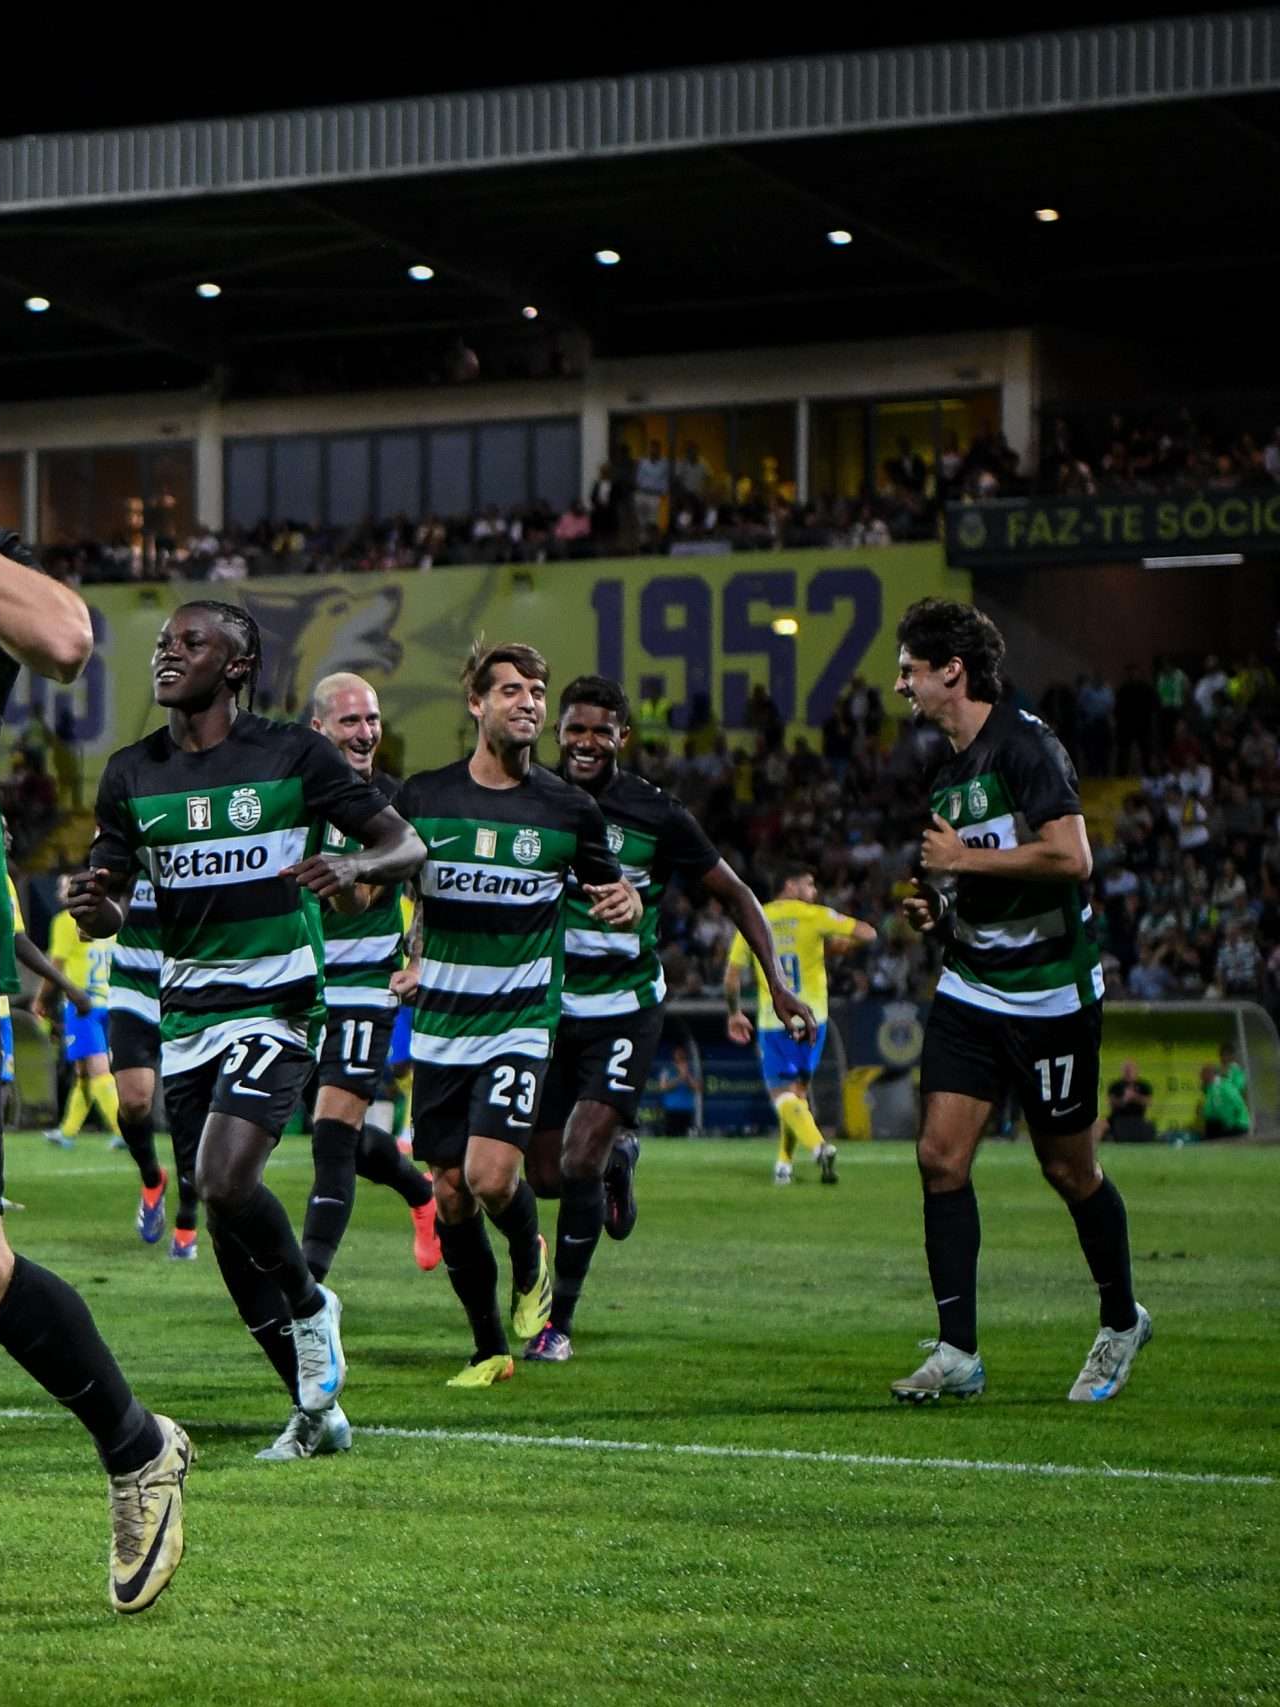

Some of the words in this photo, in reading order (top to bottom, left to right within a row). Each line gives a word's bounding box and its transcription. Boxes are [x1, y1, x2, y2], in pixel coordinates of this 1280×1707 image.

[1007, 505, 1144, 548] FAZ-TE
[591, 566, 882, 730] 1952
[156, 846, 268, 880] Betano
[437, 866, 539, 896] Betano
[223, 1035, 283, 1080] 57
[342, 1019, 373, 1060] 11
[607, 1038, 633, 1077] 2
[489, 1065, 536, 1115] 23
[1034, 1054, 1074, 1101] 17
